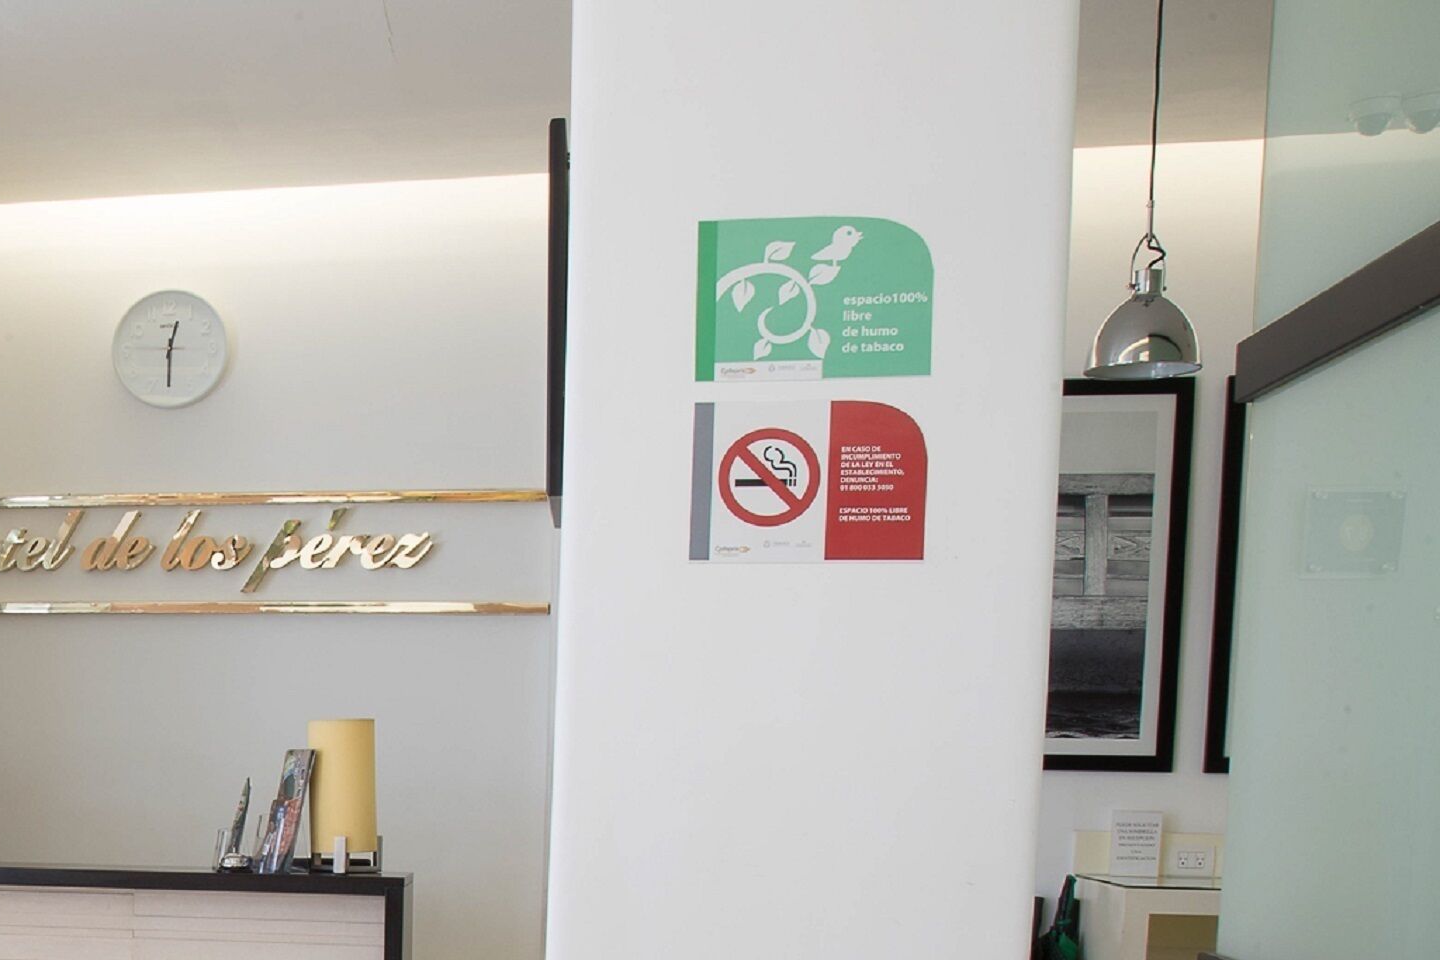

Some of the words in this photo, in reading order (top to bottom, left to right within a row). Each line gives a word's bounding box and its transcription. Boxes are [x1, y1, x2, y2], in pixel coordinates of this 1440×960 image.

[843, 310, 872, 321] libre
[842, 326, 859, 337] de
[861, 325, 898, 336] humo
[841, 342, 858, 353] de
[861, 341, 904, 352] tabaco
[79, 510, 157, 571] de
[160, 509, 254, 571] los
[240, 506, 435, 594] pérez
